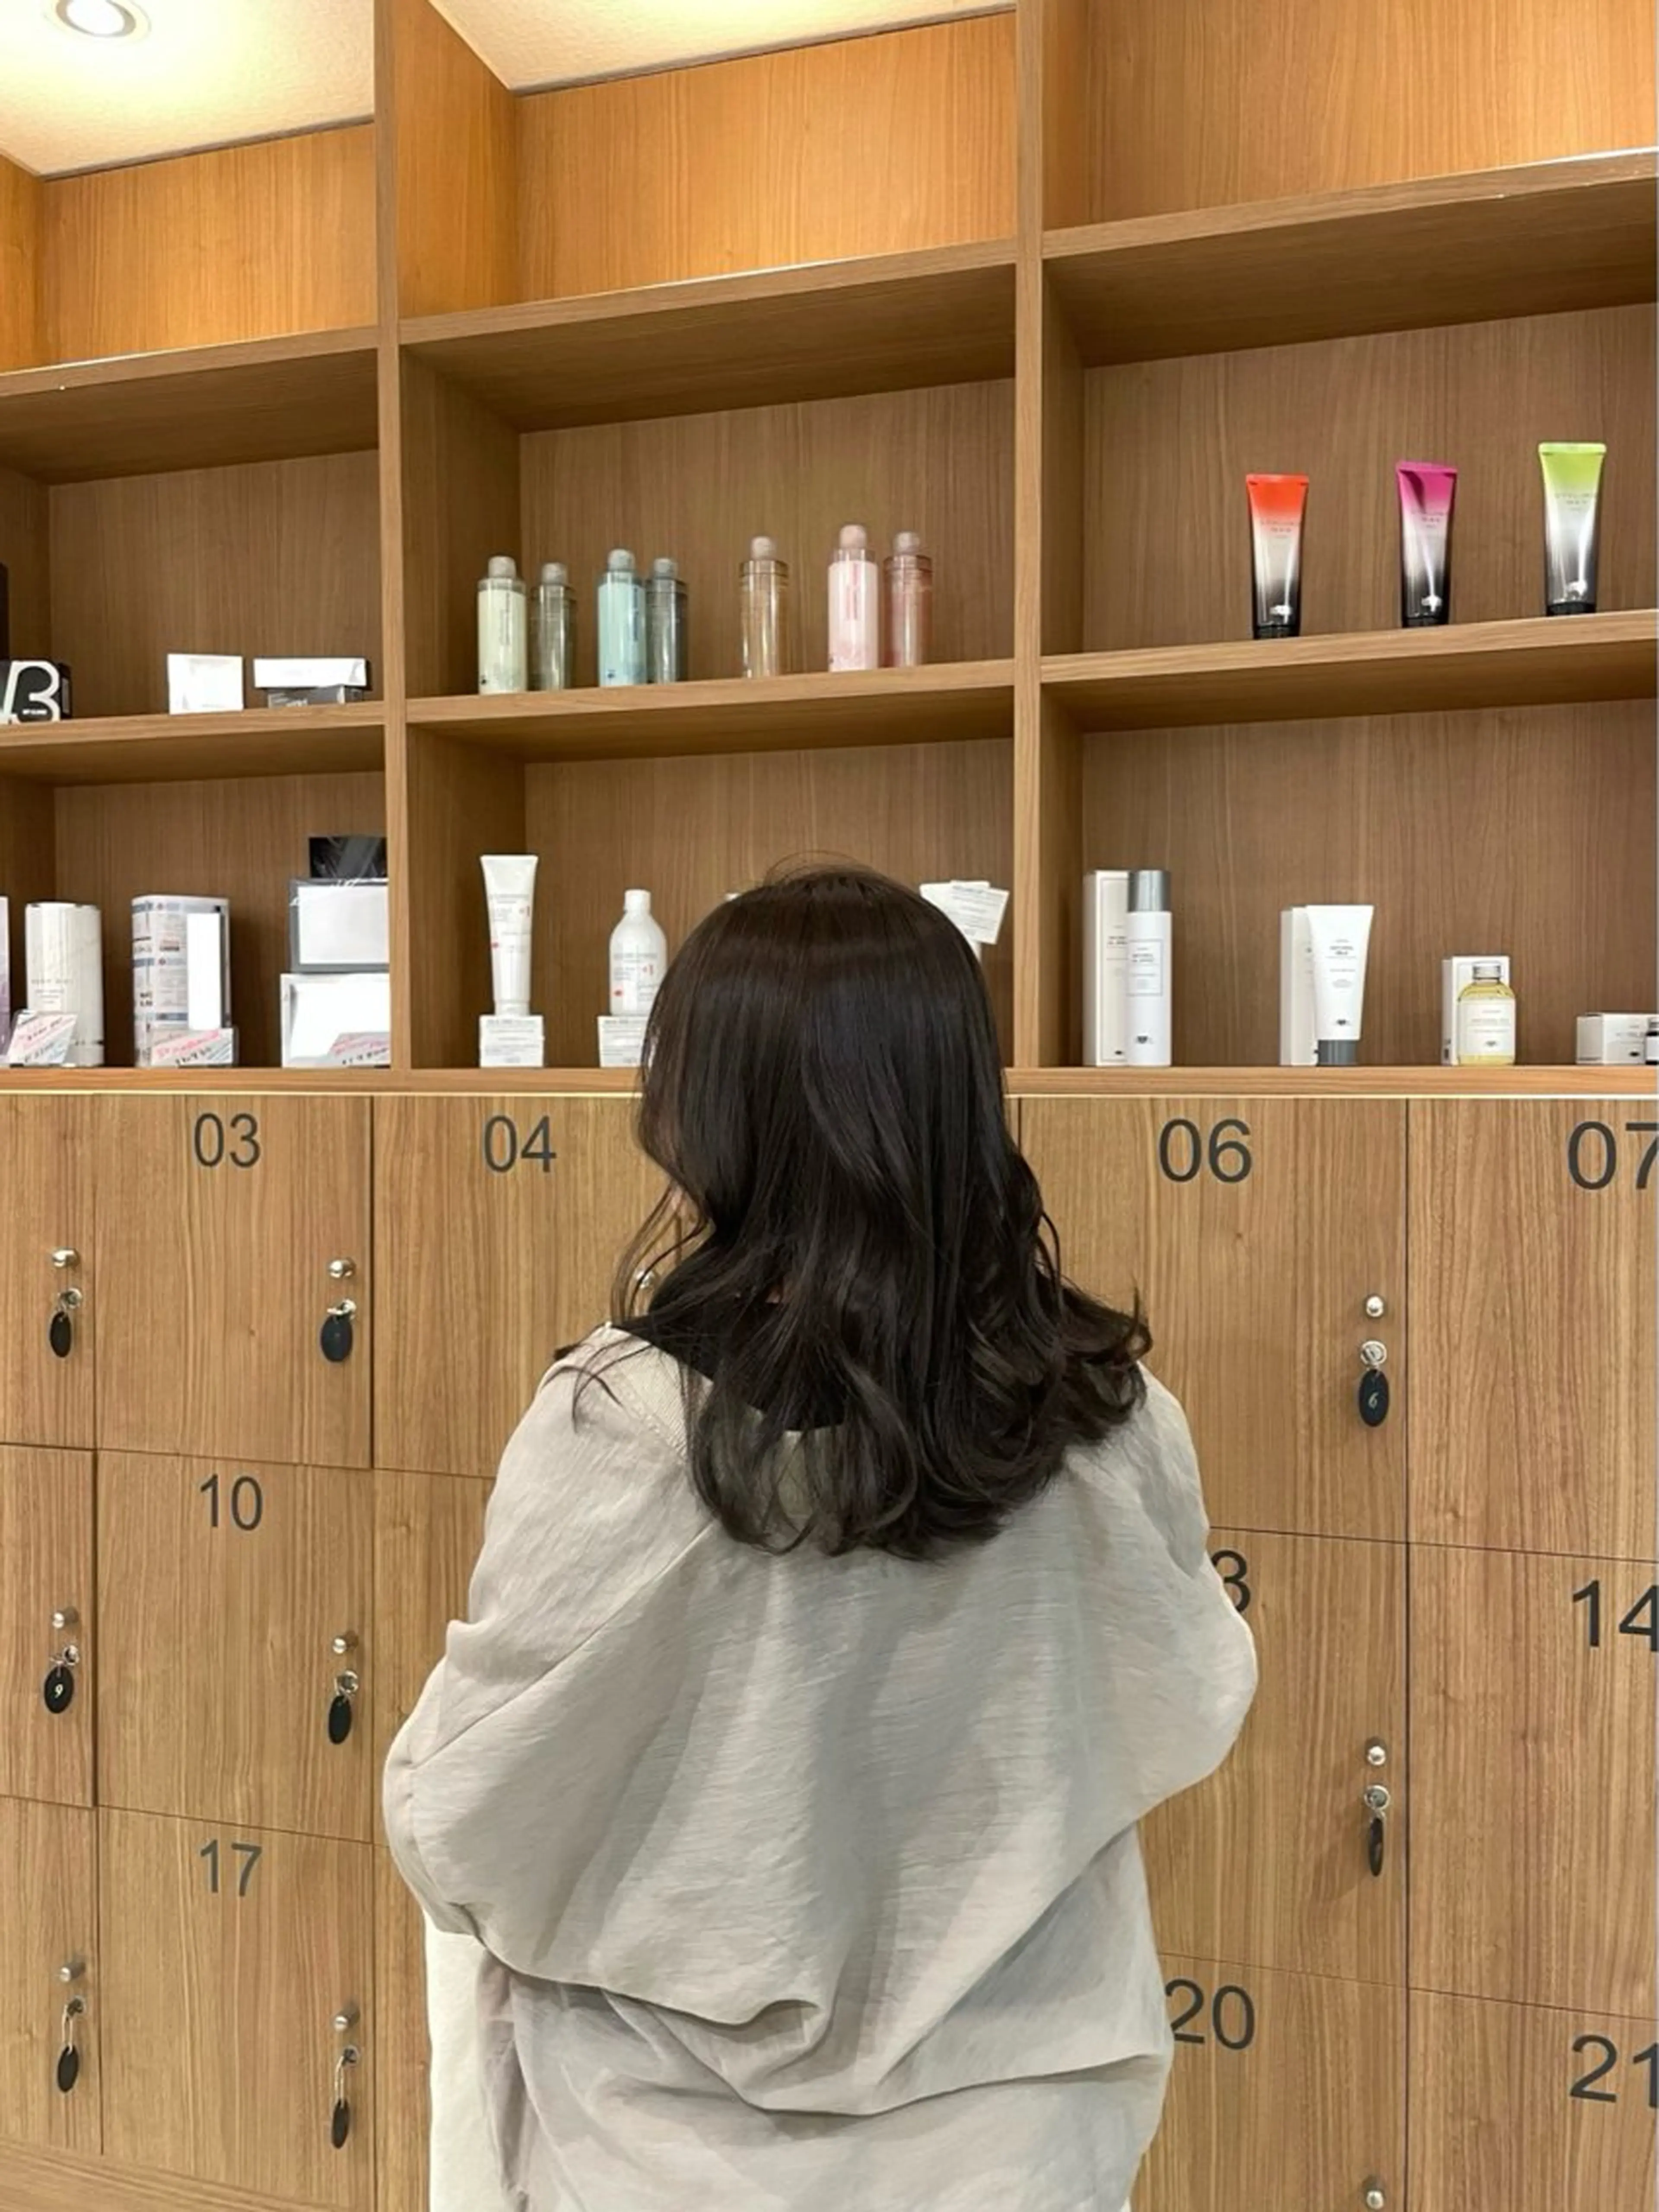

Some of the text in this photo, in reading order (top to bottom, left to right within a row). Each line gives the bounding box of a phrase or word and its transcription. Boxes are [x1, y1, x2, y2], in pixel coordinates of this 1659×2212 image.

[195, 1113, 260, 1168] 03
[484, 1116, 557, 1173] 04
[1160, 1119, 1252, 1183] 06
[1568, 1122, 1659, 1190] 07
[1368, 1392, 1379, 1409] 6
[200, 1474, 262, 1531] 10
[1211, 1550, 1250, 1613] 3
[1573, 1580, 1659, 1652] 14
[54, 1684, 64, 1699] 9
[200, 1840, 262, 1897] 17
[1165, 1979, 1255, 2050] 20
[1570, 2035, 1659, 2108] 21
